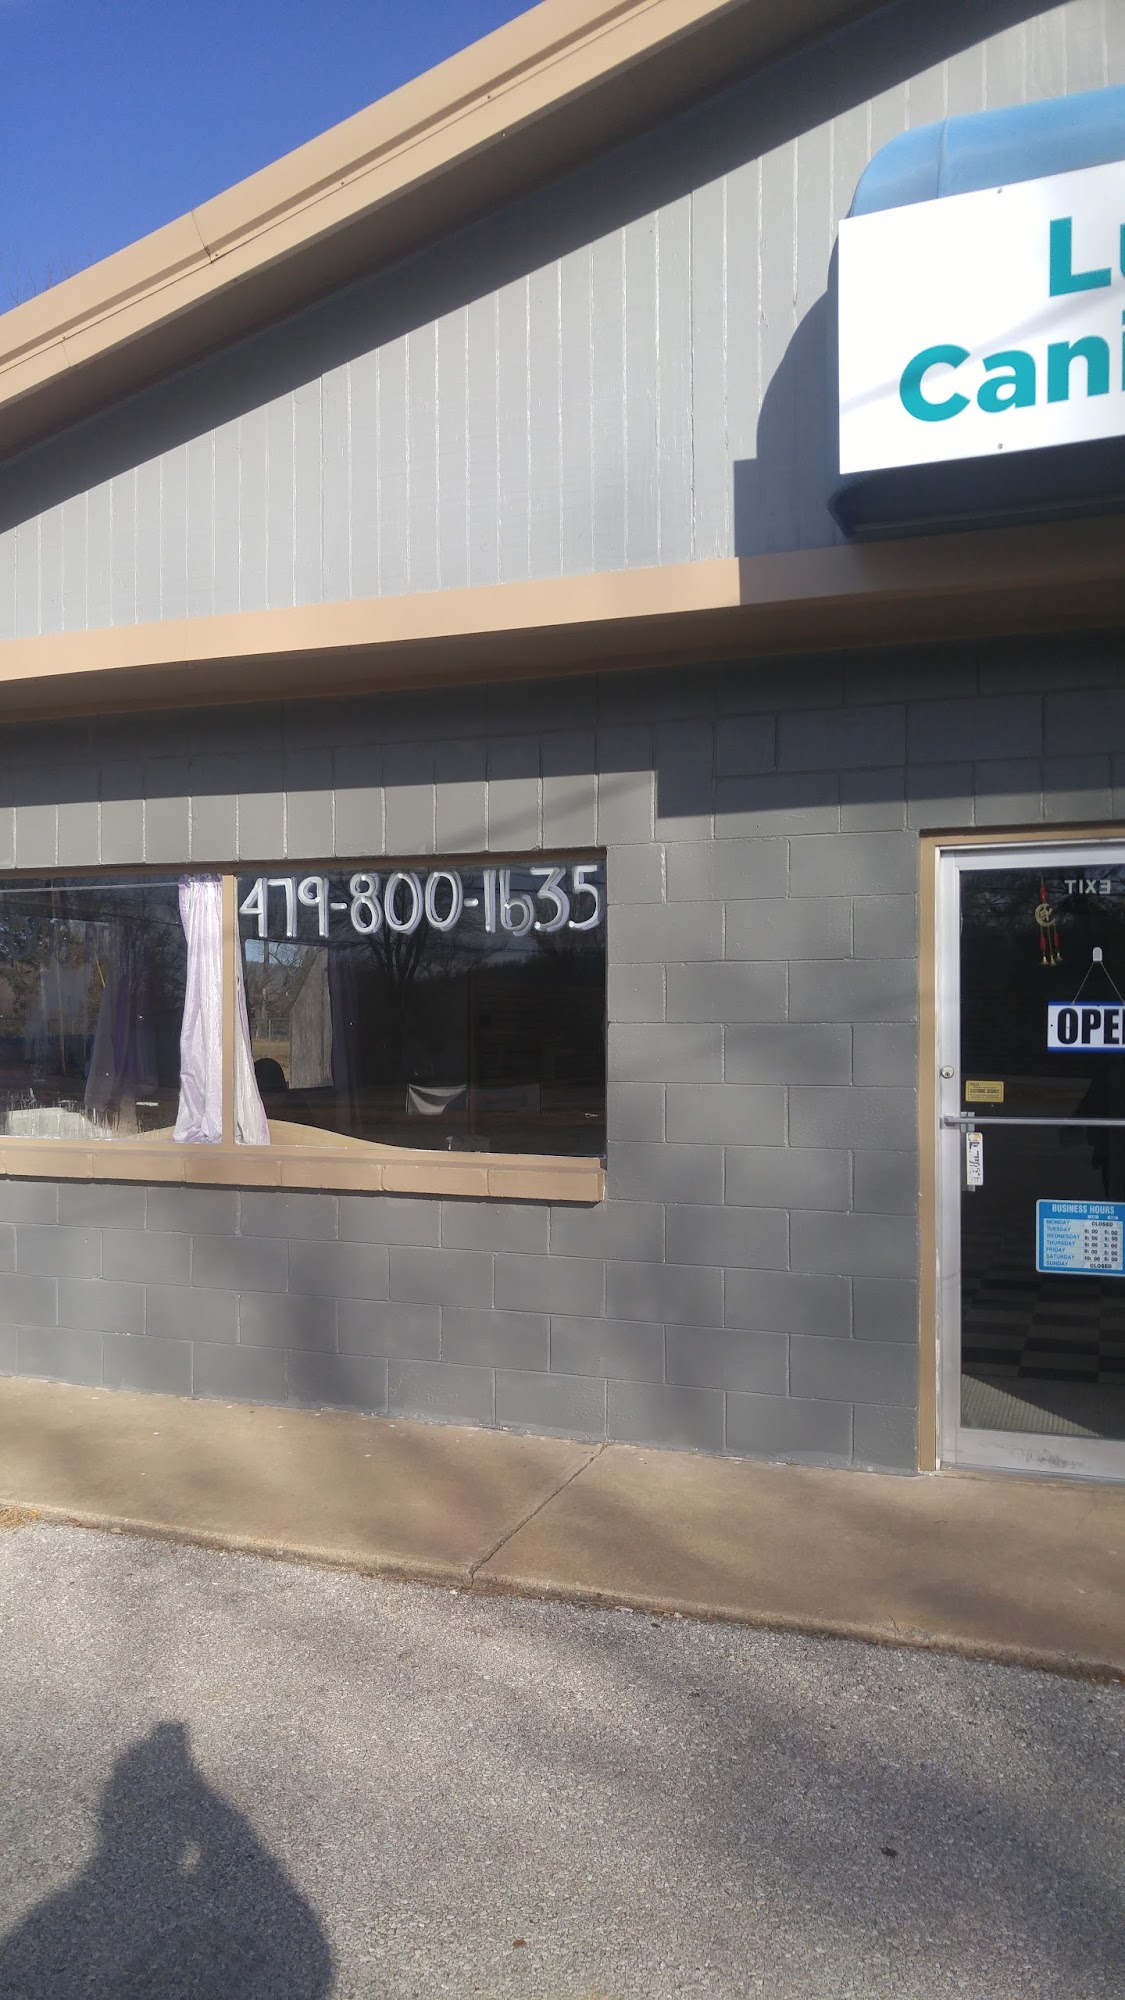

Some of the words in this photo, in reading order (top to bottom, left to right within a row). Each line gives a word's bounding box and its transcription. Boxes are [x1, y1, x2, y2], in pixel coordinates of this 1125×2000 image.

[1049, 216, 1125, 298] L
[900, 310, 1125, 422] Can
[239, 864, 600, 937] 479-800-1635
[1057, 1007, 1125, 1045] OPE
[1052, 1204, 1088, 1214] BUSINESS
[1090, 1206, 1114, 1214] HOURS
